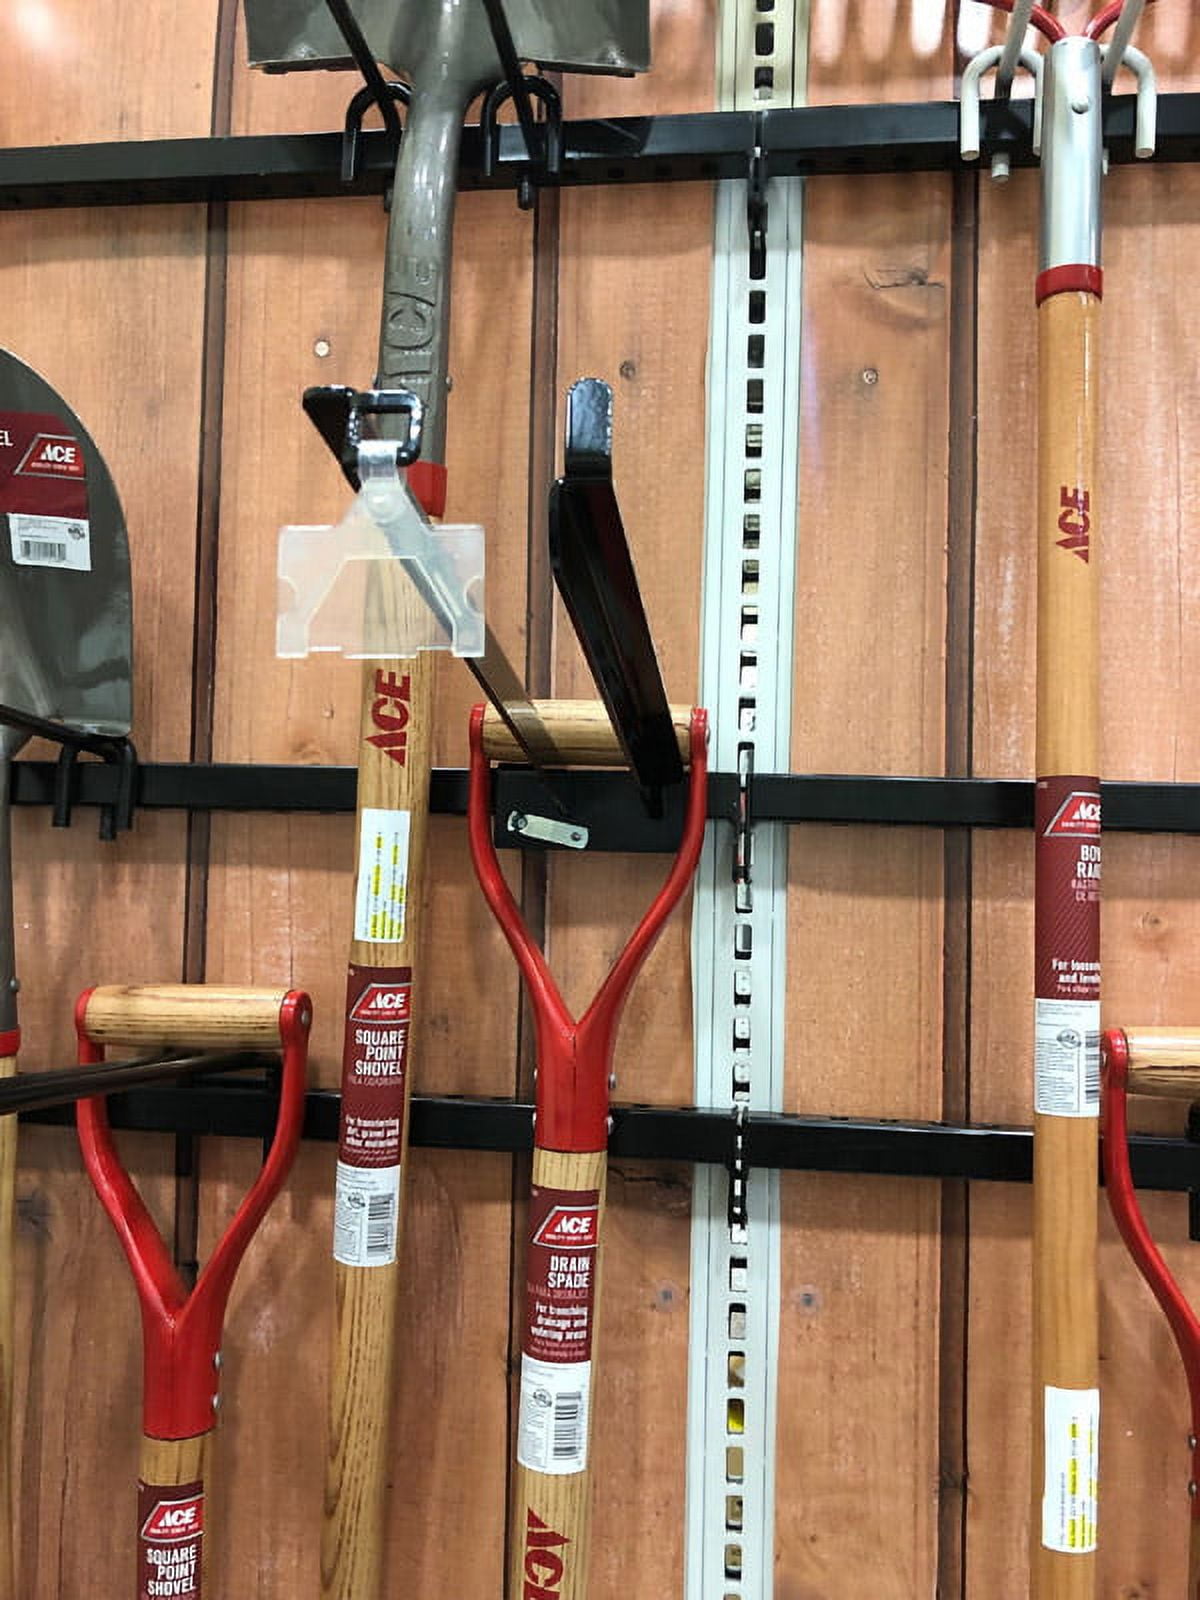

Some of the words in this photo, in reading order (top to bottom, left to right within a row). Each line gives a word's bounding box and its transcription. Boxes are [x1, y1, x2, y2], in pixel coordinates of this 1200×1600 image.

[40, 444, 76, 463] ACE
[1056, 486, 1090, 564] ACE
[364, 669, 410, 768] ACE
[368, 992, 406, 1009] ACE
[355, 1029, 406, 1046] SQUARE
[366, 1045, 404, 1061] POINT
[355, 1060, 403, 1076] SHOVEL
[554, 1216, 592, 1234] ACE
[551, 1255, 590, 1272] DRAIN
[548, 1272, 590, 1289] SPADE
[158, 1507, 196, 1527] ACE
[147, 1544, 197, 1565] SQUARE
[158, 1559, 196, 1580] POINT
[147, 1576, 196, 1596] SHOVEL
